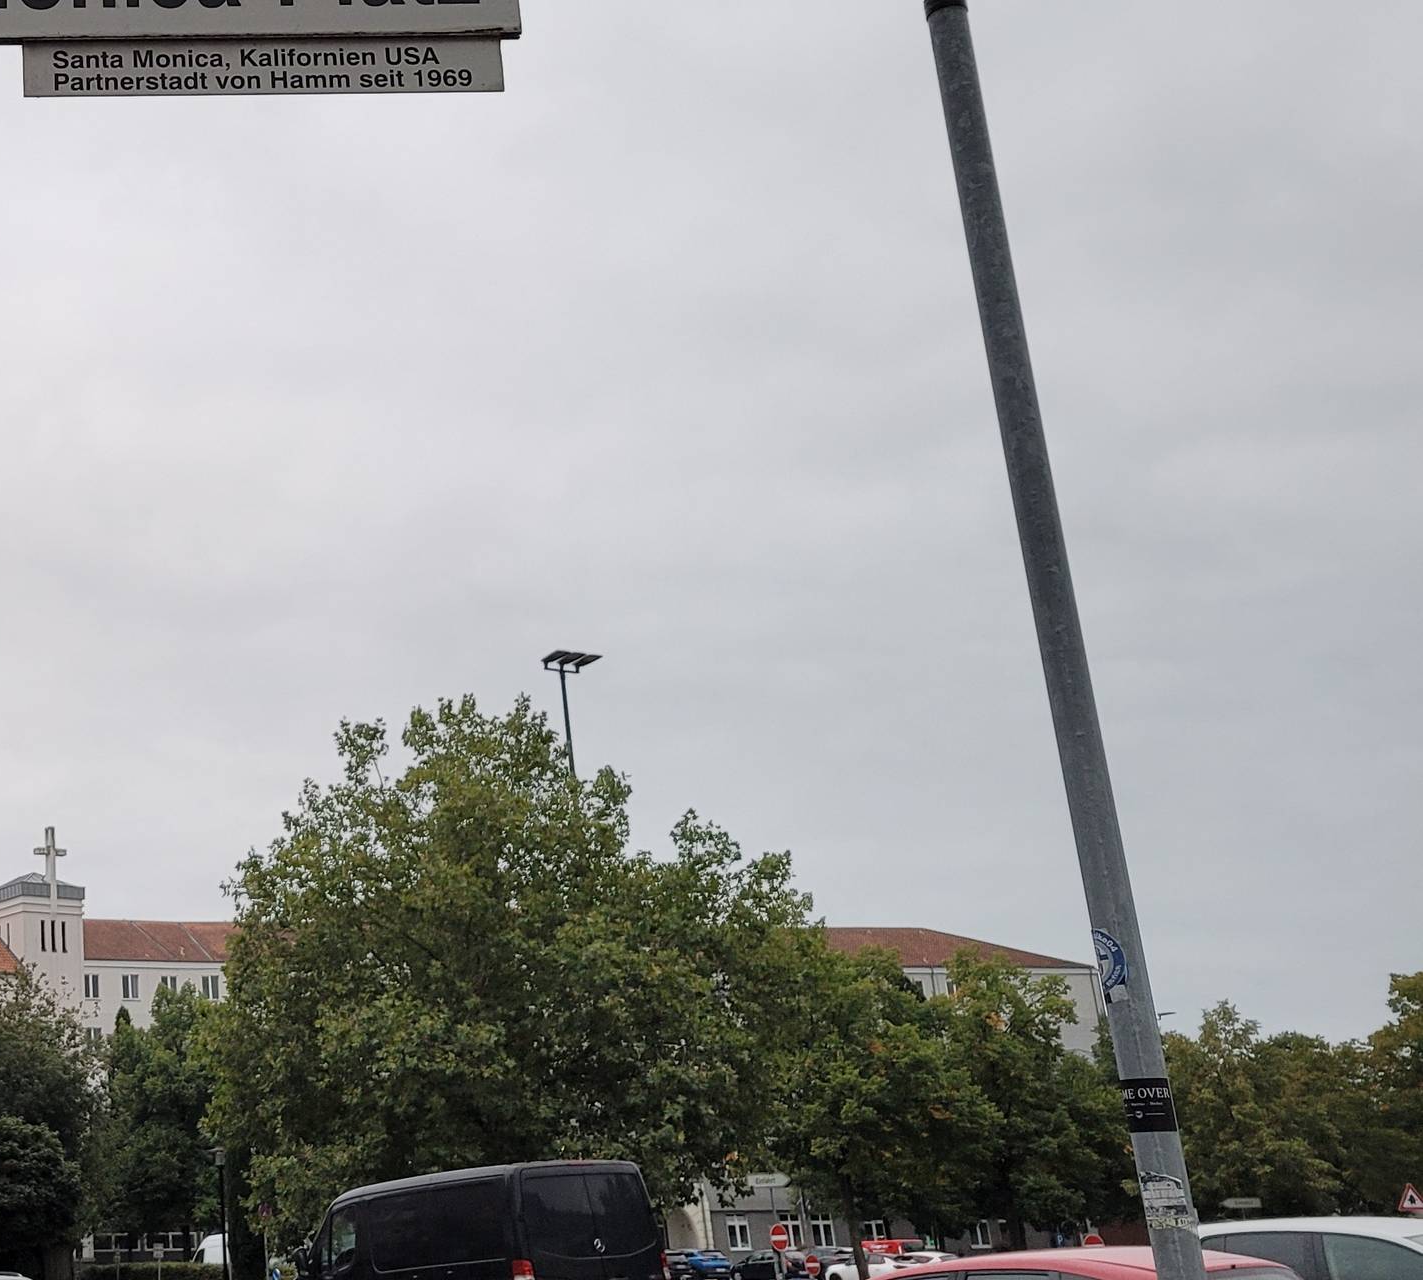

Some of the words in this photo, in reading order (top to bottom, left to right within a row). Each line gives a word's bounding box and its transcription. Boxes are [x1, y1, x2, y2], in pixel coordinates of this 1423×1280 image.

[53, 50, 123, 69] Santa
[133, 50, 231, 71] Monica,
[240, 48, 375, 66] Kalifornien
[385, 47, 440, 65] USA
[54, 72, 208, 91] Partnerstadt
[216, 75, 260, 89] von
[271, 71, 350, 88] Hamm
[360, 70, 404, 88] seit
[414, 69, 472, 87] 1969
[1137, 1088, 1170, 1098] OVER
